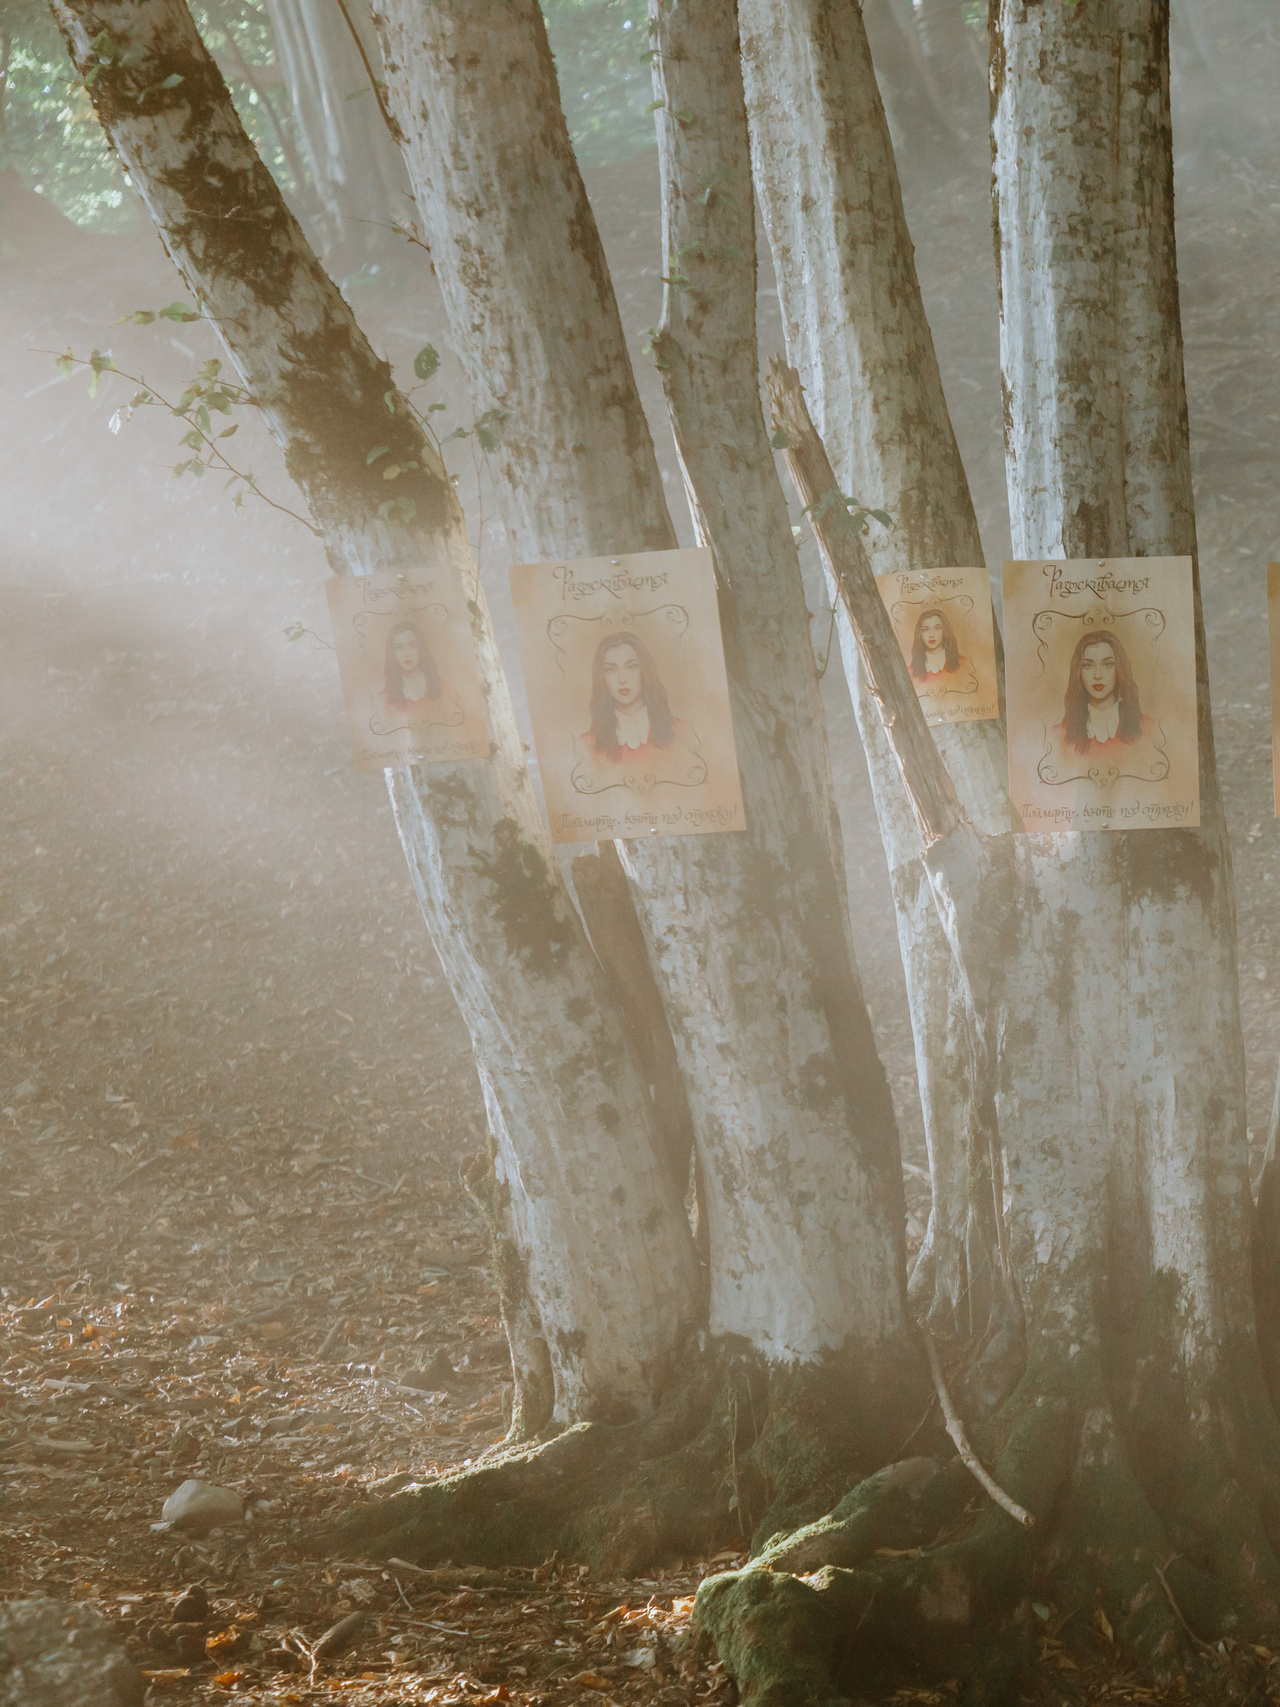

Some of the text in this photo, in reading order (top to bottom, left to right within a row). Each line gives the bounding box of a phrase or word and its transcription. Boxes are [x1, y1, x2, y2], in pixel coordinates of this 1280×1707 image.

[552, 565, 669, 601] Разыскивается
[896, 574, 963, 594] Разыскивается
[1042, 564, 1150, 600] Разыскивается
[662, 806, 682, 824] под
[684, 804, 738, 827] стражу!
[1120, 800, 1141, 818] под
[1142, 800, 1194, 822] стражу!
